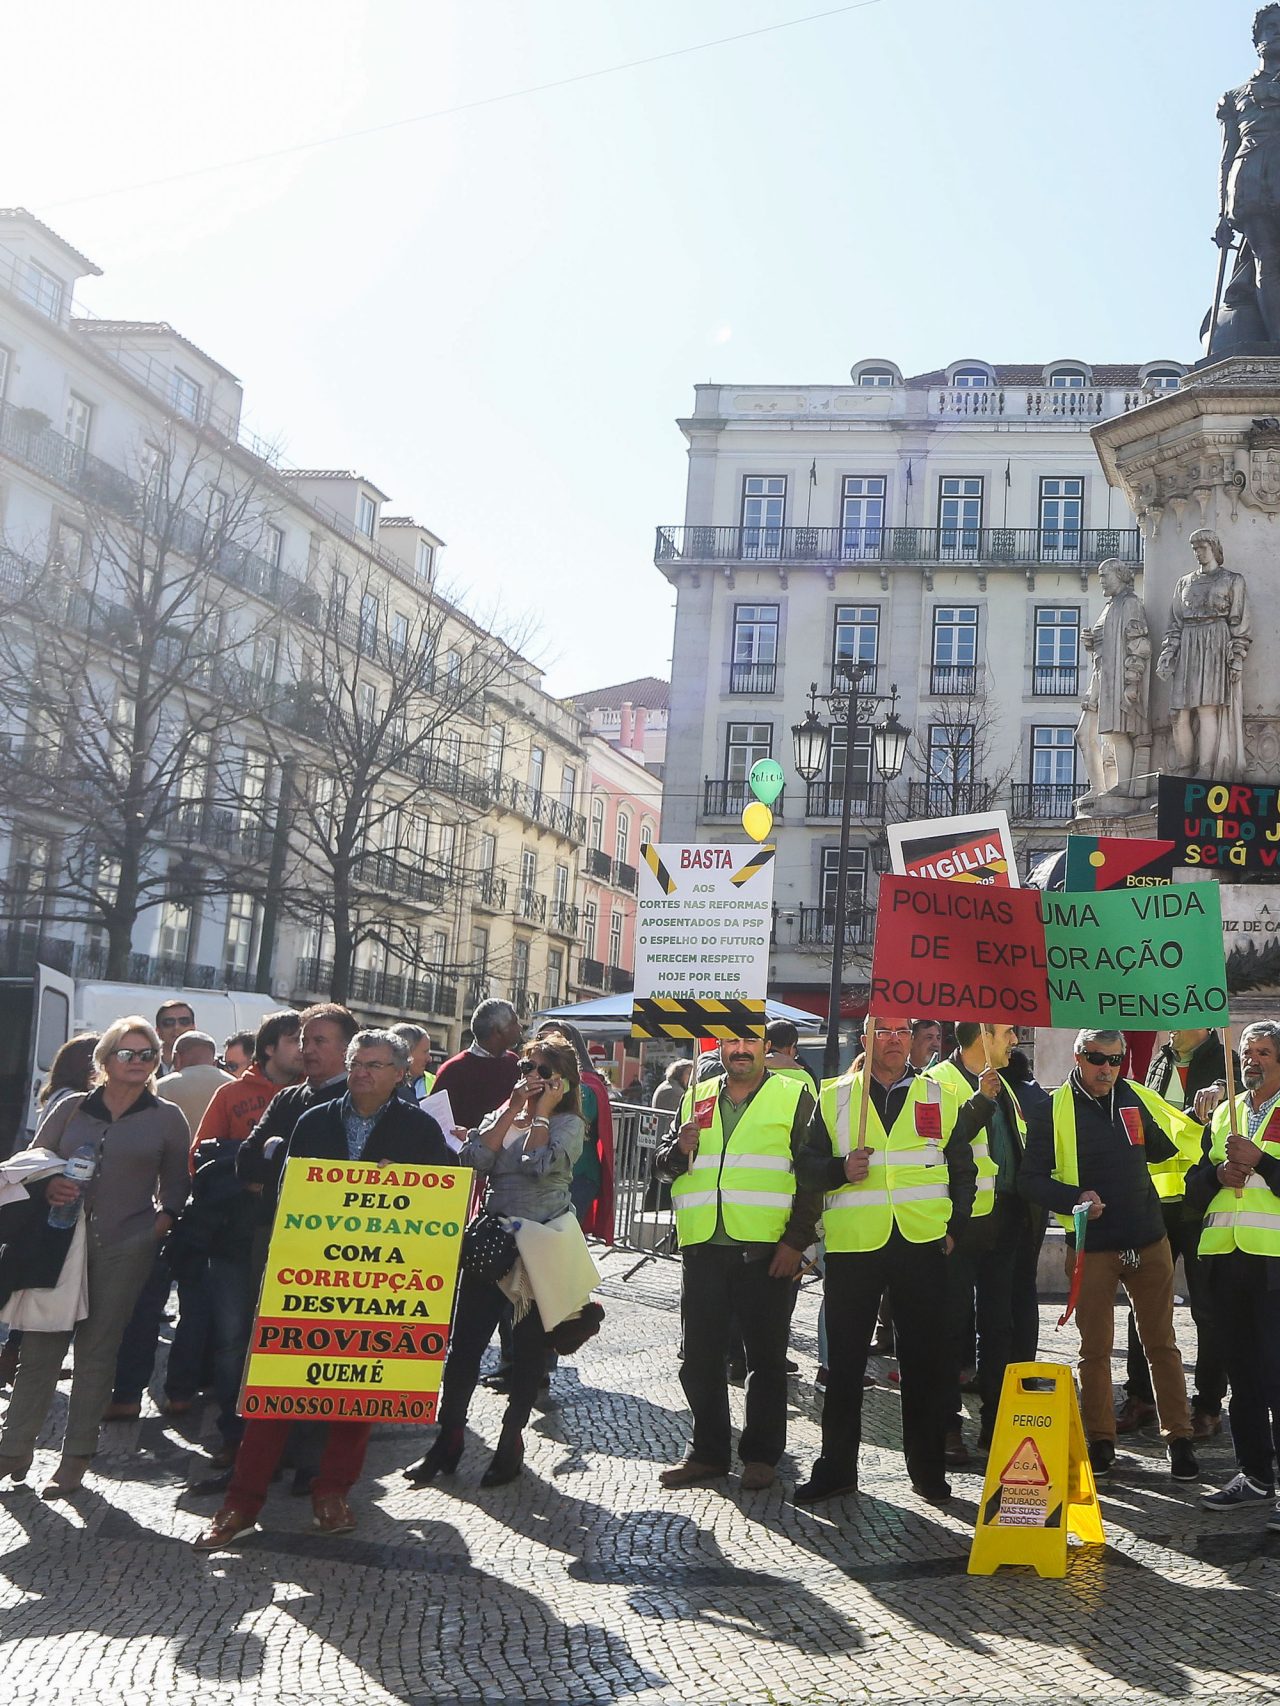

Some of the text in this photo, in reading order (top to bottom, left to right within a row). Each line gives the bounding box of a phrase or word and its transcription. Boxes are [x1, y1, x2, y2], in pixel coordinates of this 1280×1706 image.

[681, 849, 733, 869] BASTA
[693, 884, 715, 893] AOS
[639, 901, 769, 910] CORTES NAS REFORMAS
[893, 890, 1205, 928] POLICIAS UMA VIDA
[1260, 904, 1271, 915] A
[641, 918, 764, 927] APOSENTADOS DA PSP
[1244, 921, 1261, 932] DE
[639, 936, 764, 945] O ESPELHO DO FUTURO
[646, 954, 754, 964] MERECEM RESPEITO
[911, 935, 1183, 976] DE EXPLORAÇÃO
[658, 973, 740, 982] HOJE POR ELES
[649, 988, 747, 999] AMANHÃ POR NÓS
[871, 977, 1227, 1017] ROUBADOS NA PENSÃO
[307, 1167, 455, 1189] ROUBADOS
[343, 1193, 410, 1210] PELO
[284, 1214, 459, 1237] NOVO BANCO
[324, 1244, 405, 1263] COM A
[277, 1268, 443, 1293] CORRUPÇÃO
[282, 1295, 429, 1317] DESVIAM A
[258, 1325, 444, 1354] PROVISÃO
[306, 1360, 384, 1383] QUEM É
[246, 1395, 434, 1418] O NOSSO LADRÃO?
[1013, 1414, 1052, 1428] PERIGO
[1014, 1461, 1038, 1471] C.G.A
[1003, 1487, 1039, 1496] POLICIAS
[1002, 1497, 1047, 1506] ROUBADOS
[1018, 1507, 1041, 1515] SUAS
[999, 1515, 1038, 1525] PENSÕES
